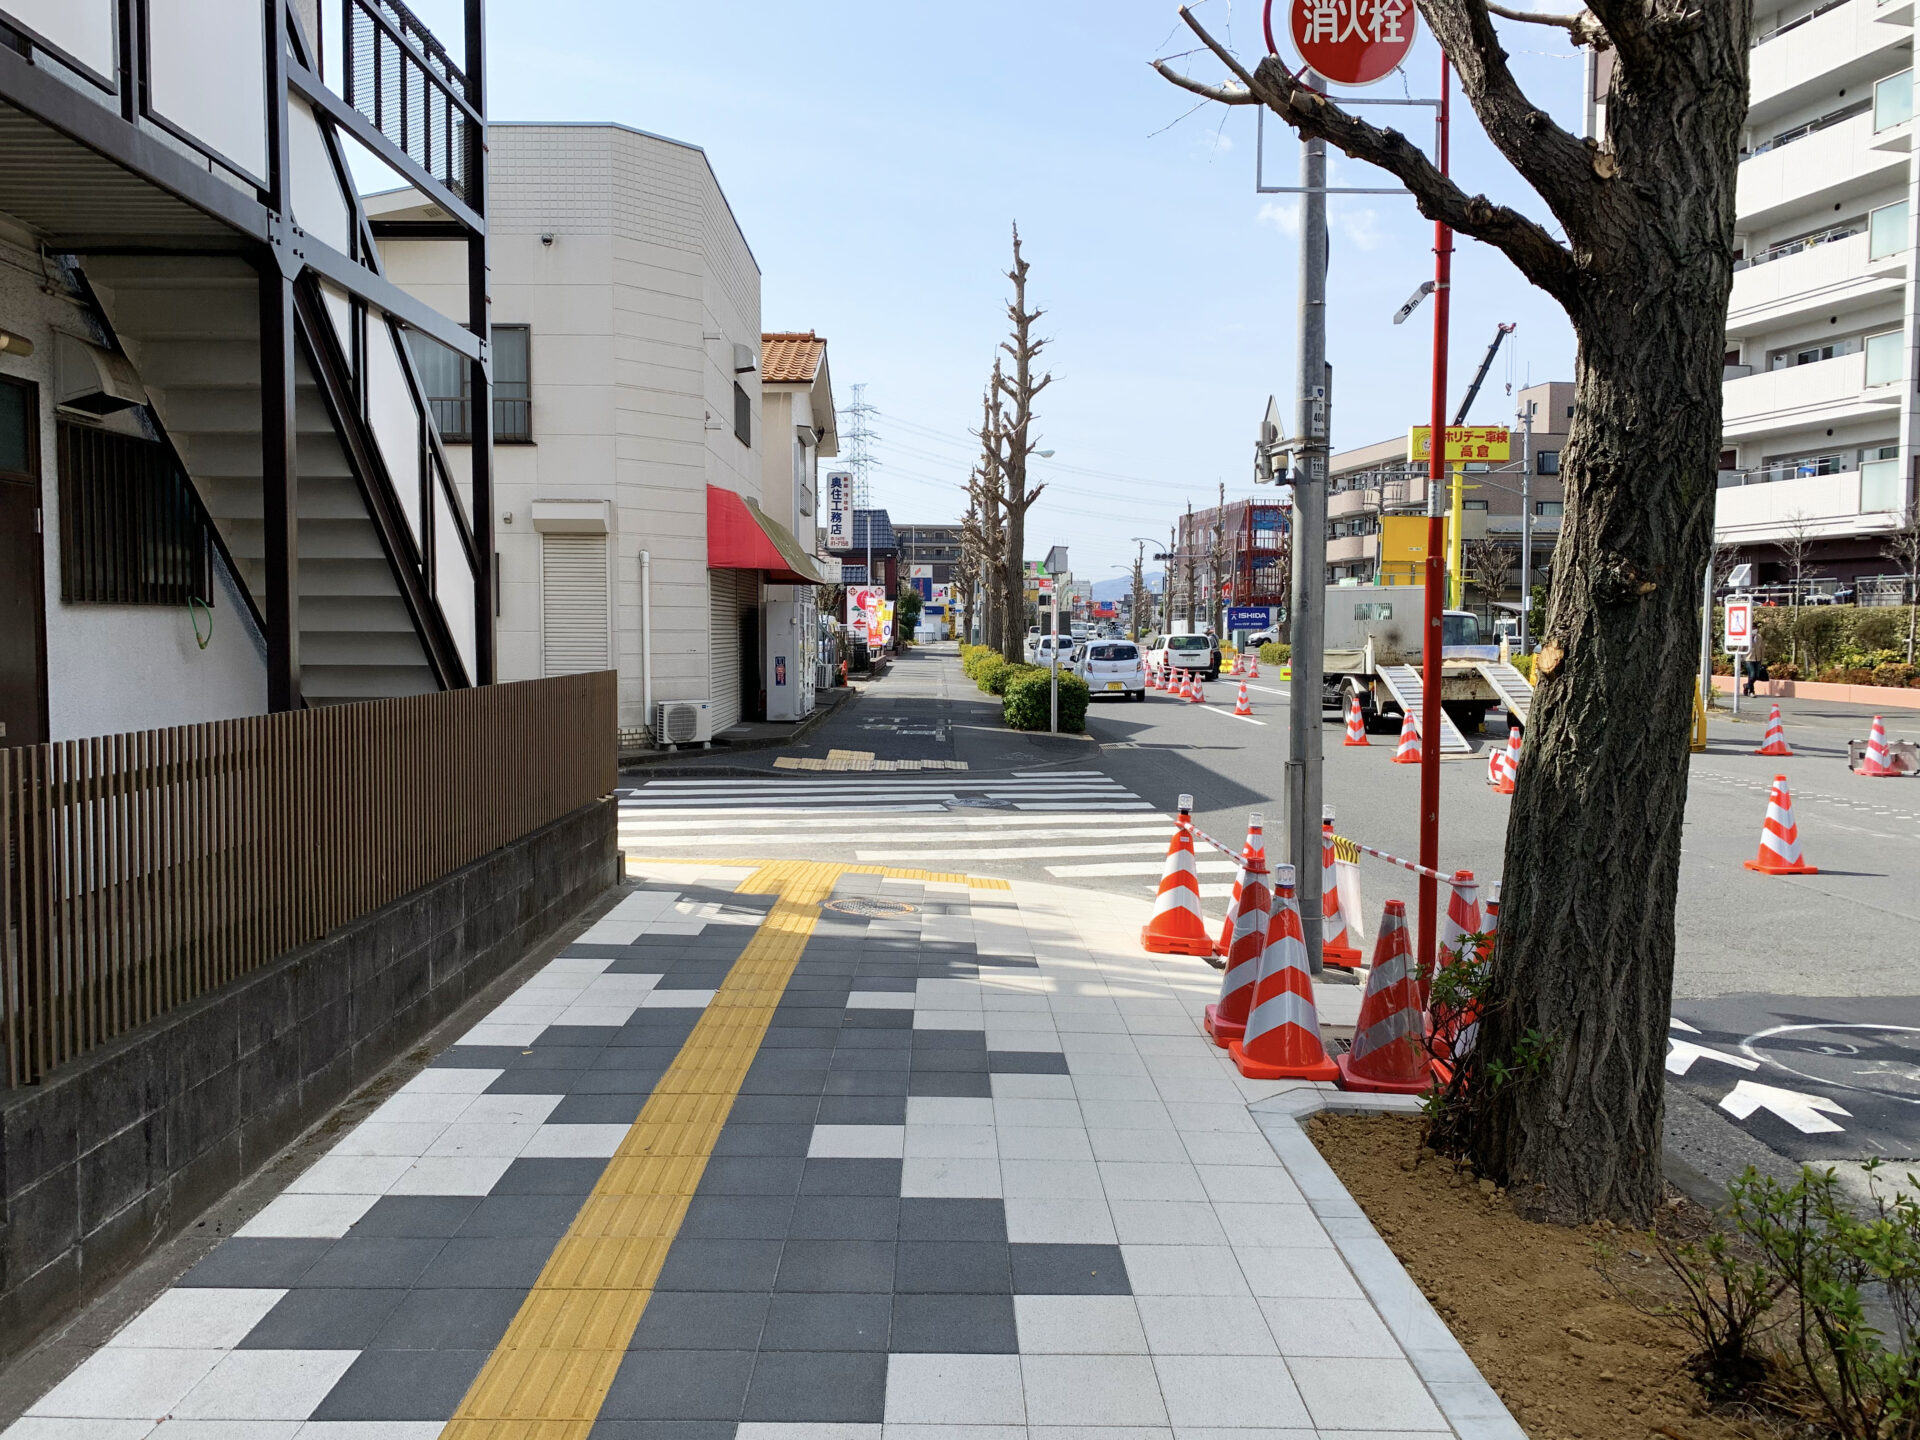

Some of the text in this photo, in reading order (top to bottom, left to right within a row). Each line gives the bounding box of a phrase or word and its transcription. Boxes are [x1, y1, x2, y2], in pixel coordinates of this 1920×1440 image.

[1303, 0, 1405, 44] 消火栓
[1401, 300, 1419, 316] 3m
[1444, 430, 1508, 444] ホリデー車検
[1460, 445, 1489, 458] 高倉
[830, 476, 843, 535] 奥住工務店
